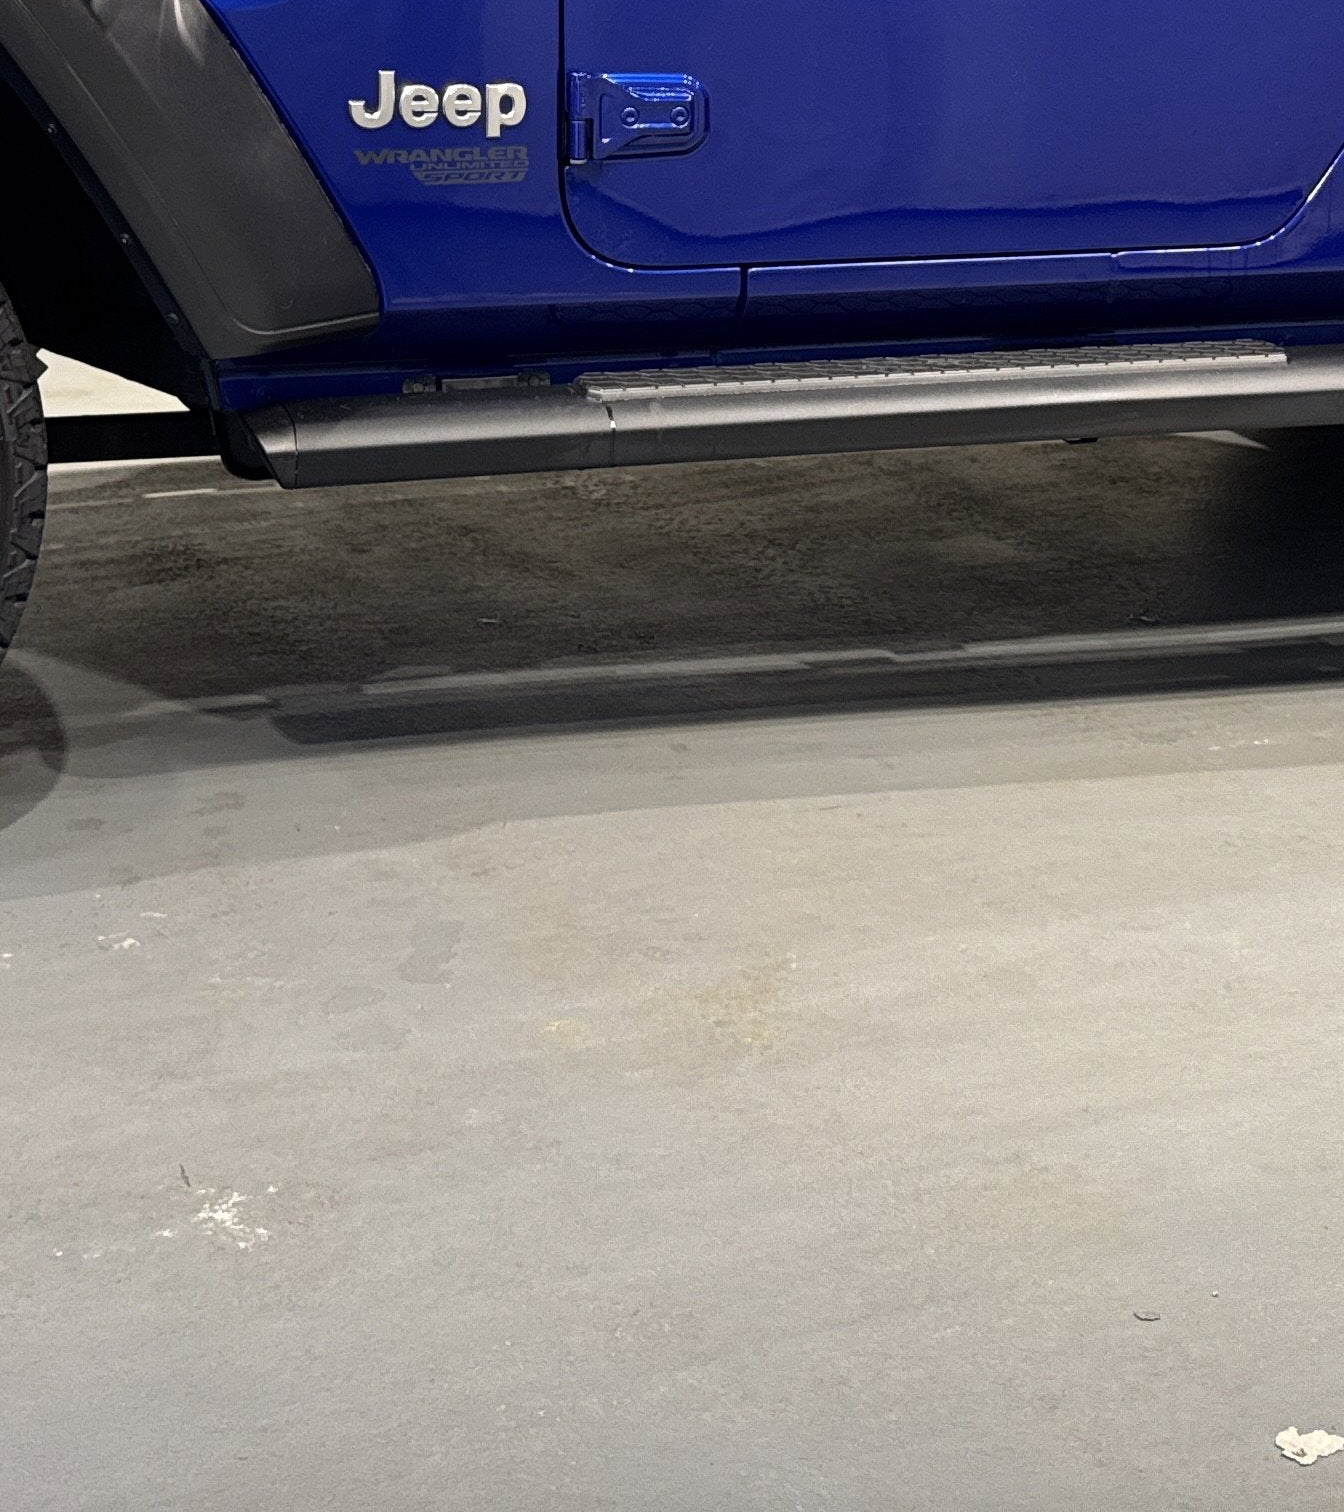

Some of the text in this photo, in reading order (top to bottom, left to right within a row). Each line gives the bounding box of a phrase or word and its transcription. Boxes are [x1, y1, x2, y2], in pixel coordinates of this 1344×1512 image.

[348, 69, 527, 138] Jeep
[353, 145, 529, 165] WRANGLER
[410, 159, 529, 170] UNLIMITED
[423, 170, 524, 183] SPORT
